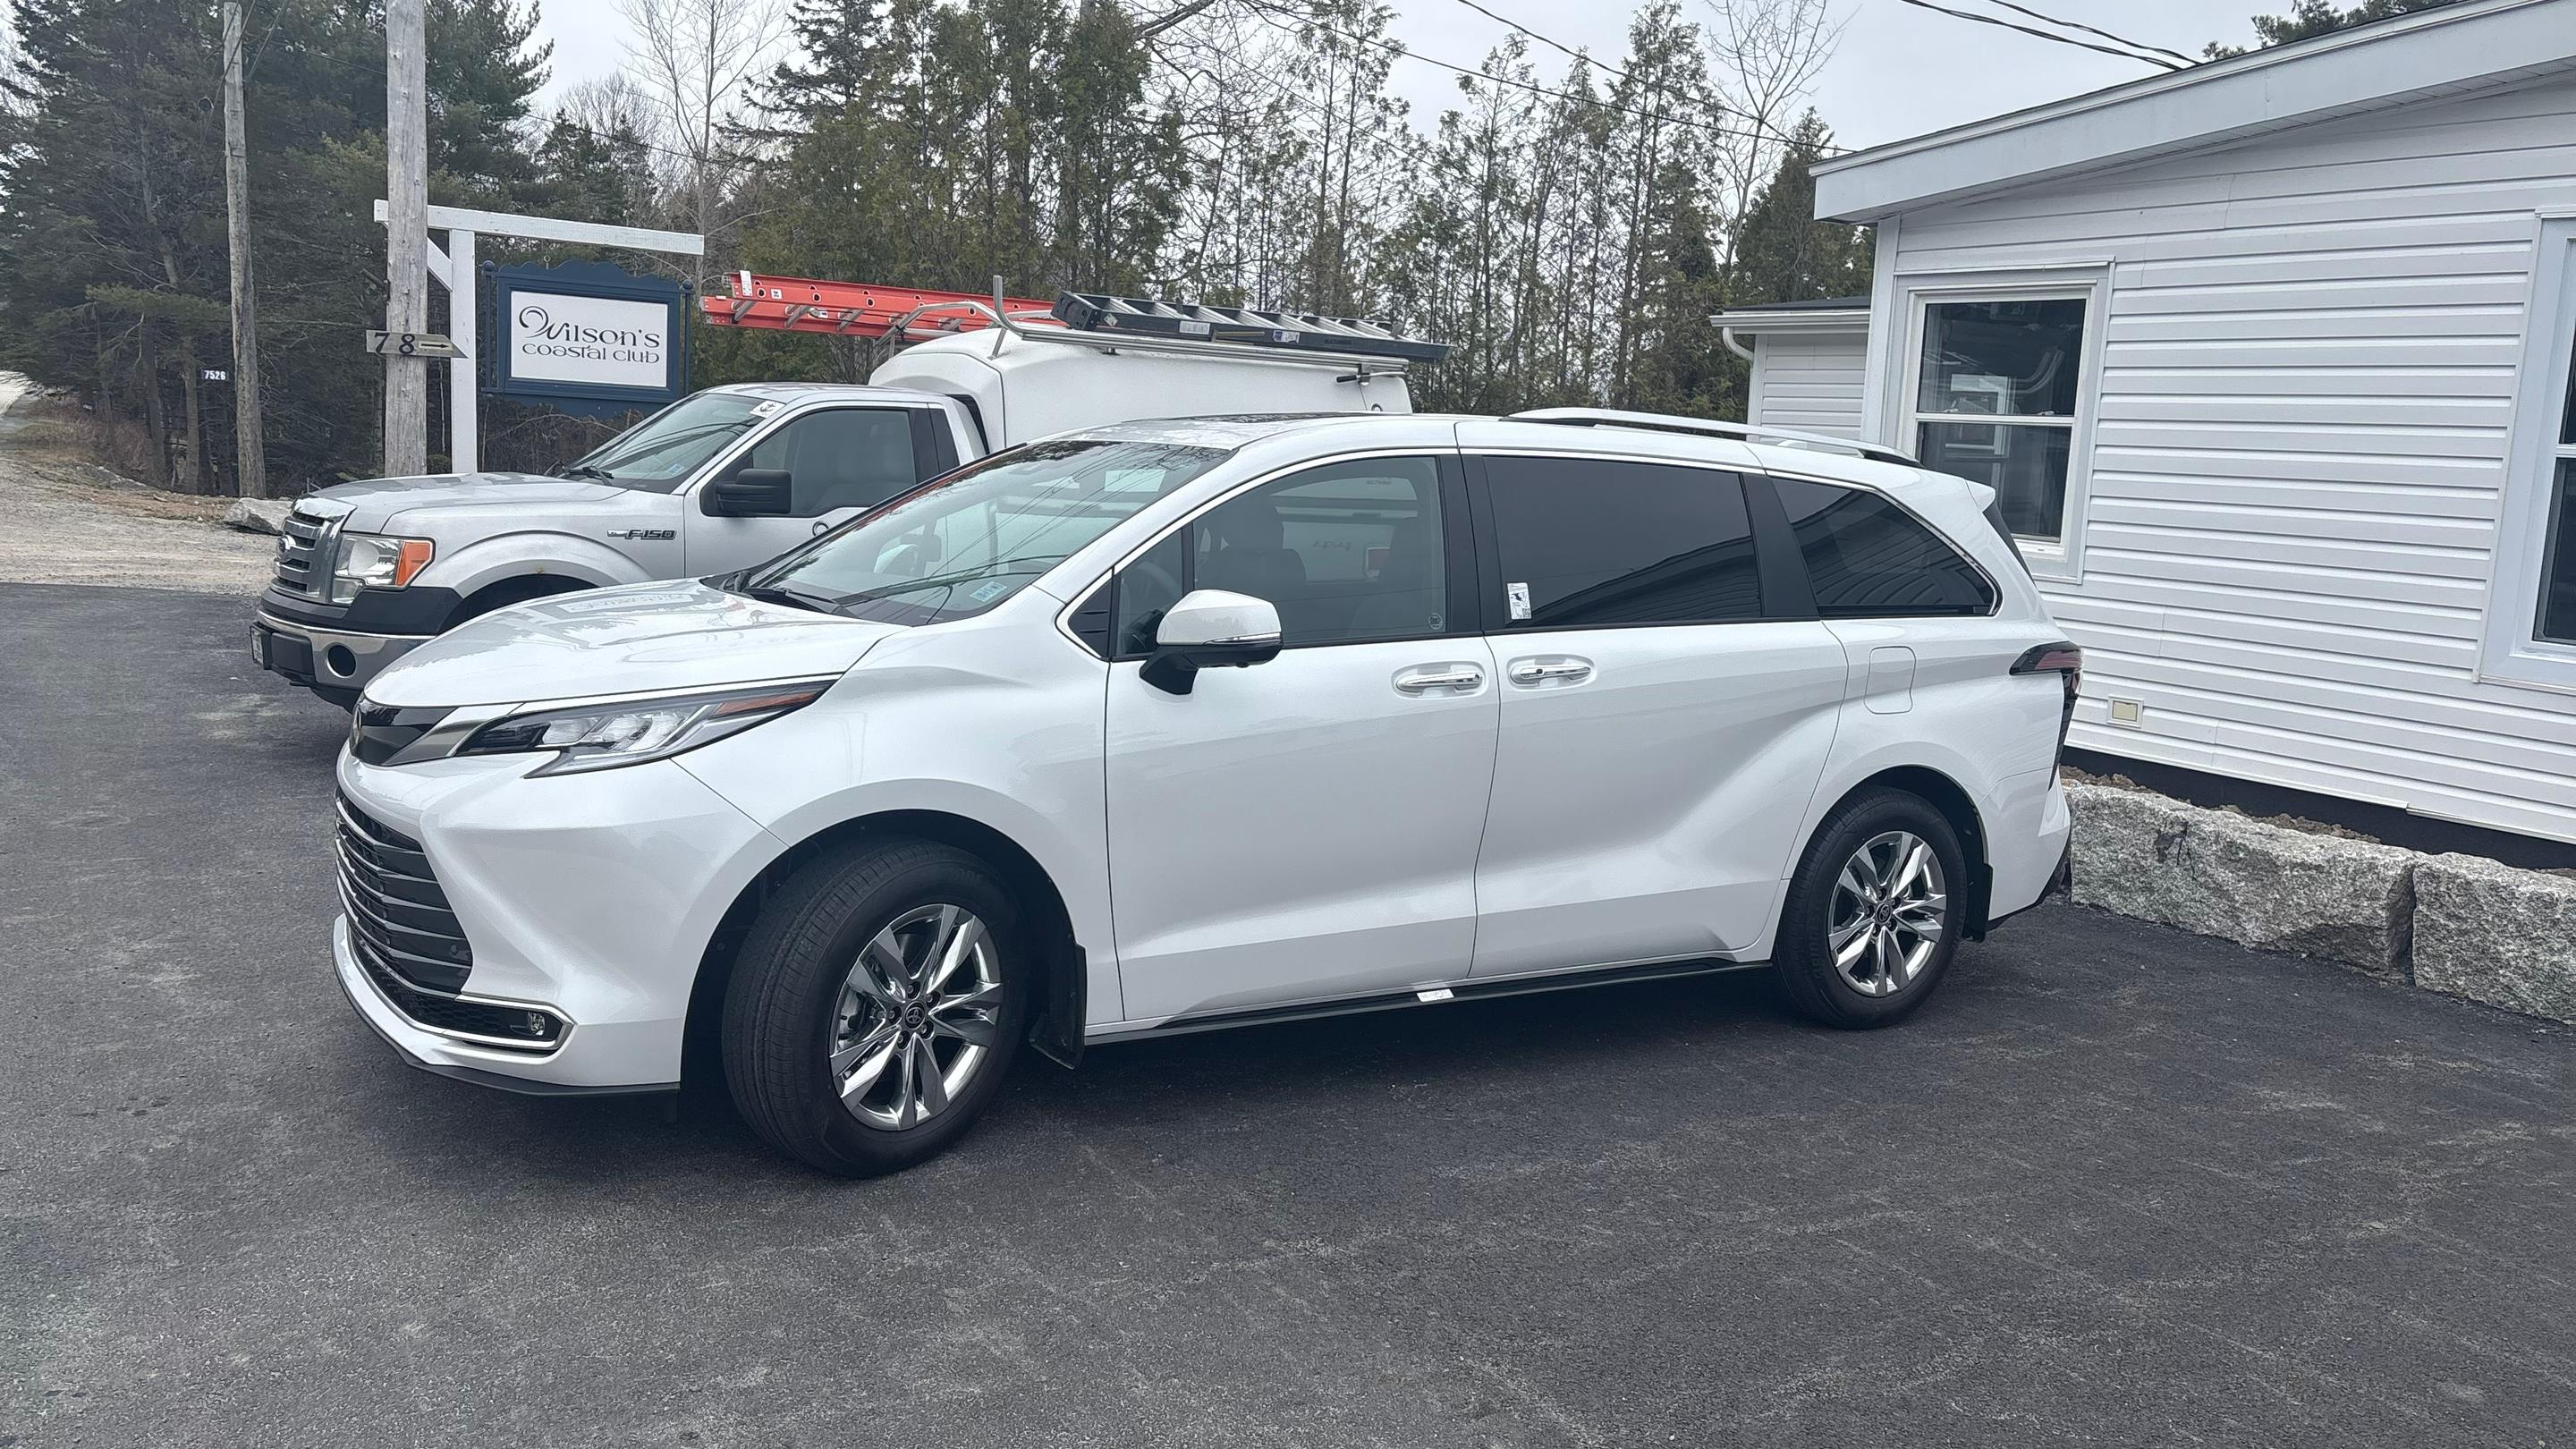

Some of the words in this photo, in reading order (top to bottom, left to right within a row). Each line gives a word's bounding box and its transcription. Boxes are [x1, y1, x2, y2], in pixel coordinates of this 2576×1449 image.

[519, 305, 660, 349] Wilson's
[521, 343, 606, 360] coastal
[613, 347, 660, 364] club
[626, 529, 677, 540] F-150
